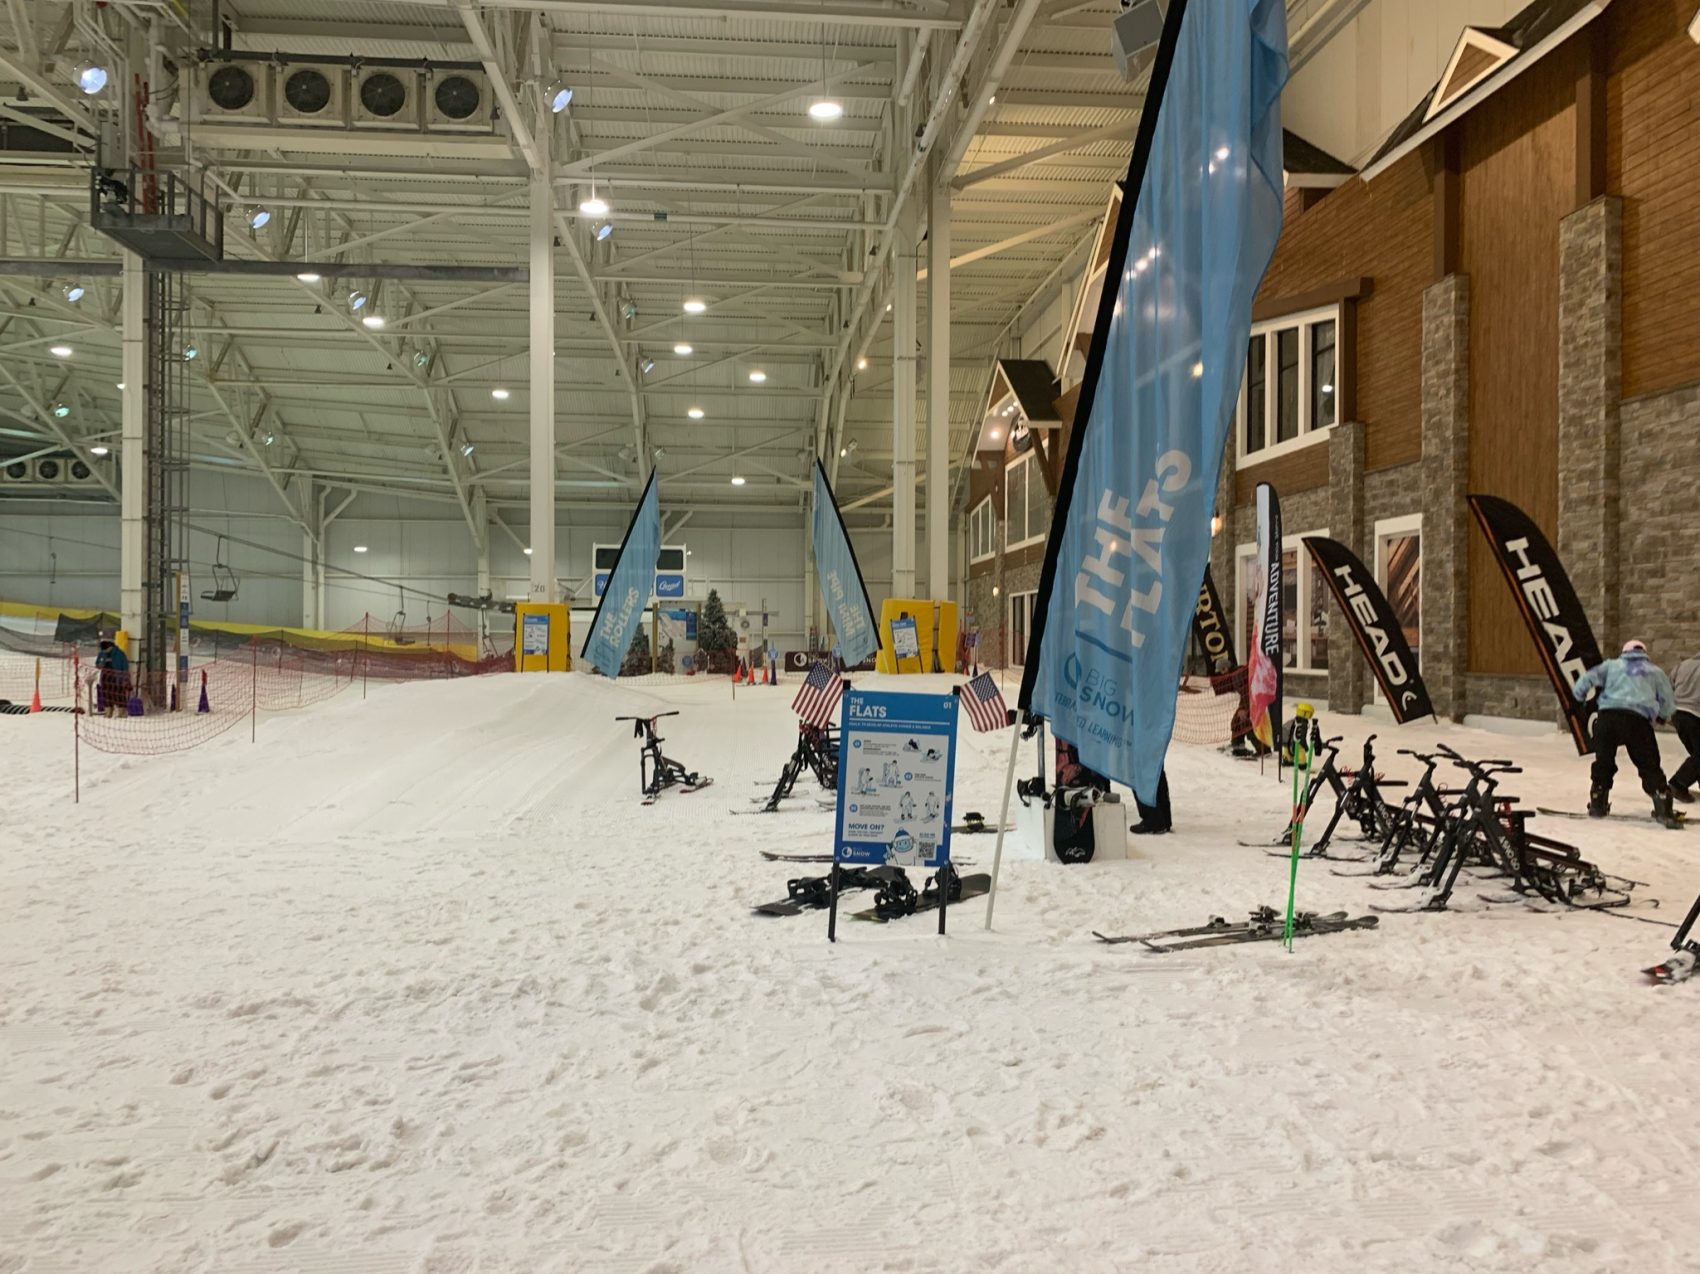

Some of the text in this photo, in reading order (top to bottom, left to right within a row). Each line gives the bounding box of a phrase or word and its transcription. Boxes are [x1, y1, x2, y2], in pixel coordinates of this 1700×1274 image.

[1075, 488, 1132, 616] THE
[600, 612, 617, 639] THE
[609, 586, 640, 648] ROLLERS
[1265, 561, 1280, 656] ADVENTURE
[1334, 564, 1408, 686] HEAD
[1505, 536, 1596, 701] HEAD
[943, 701, 952, 709] 01
[1079, 686, 1134, 727] SNOW
[1086, 668, 1118, 697] BIG
[849, 705, 887, 718] FLATS
